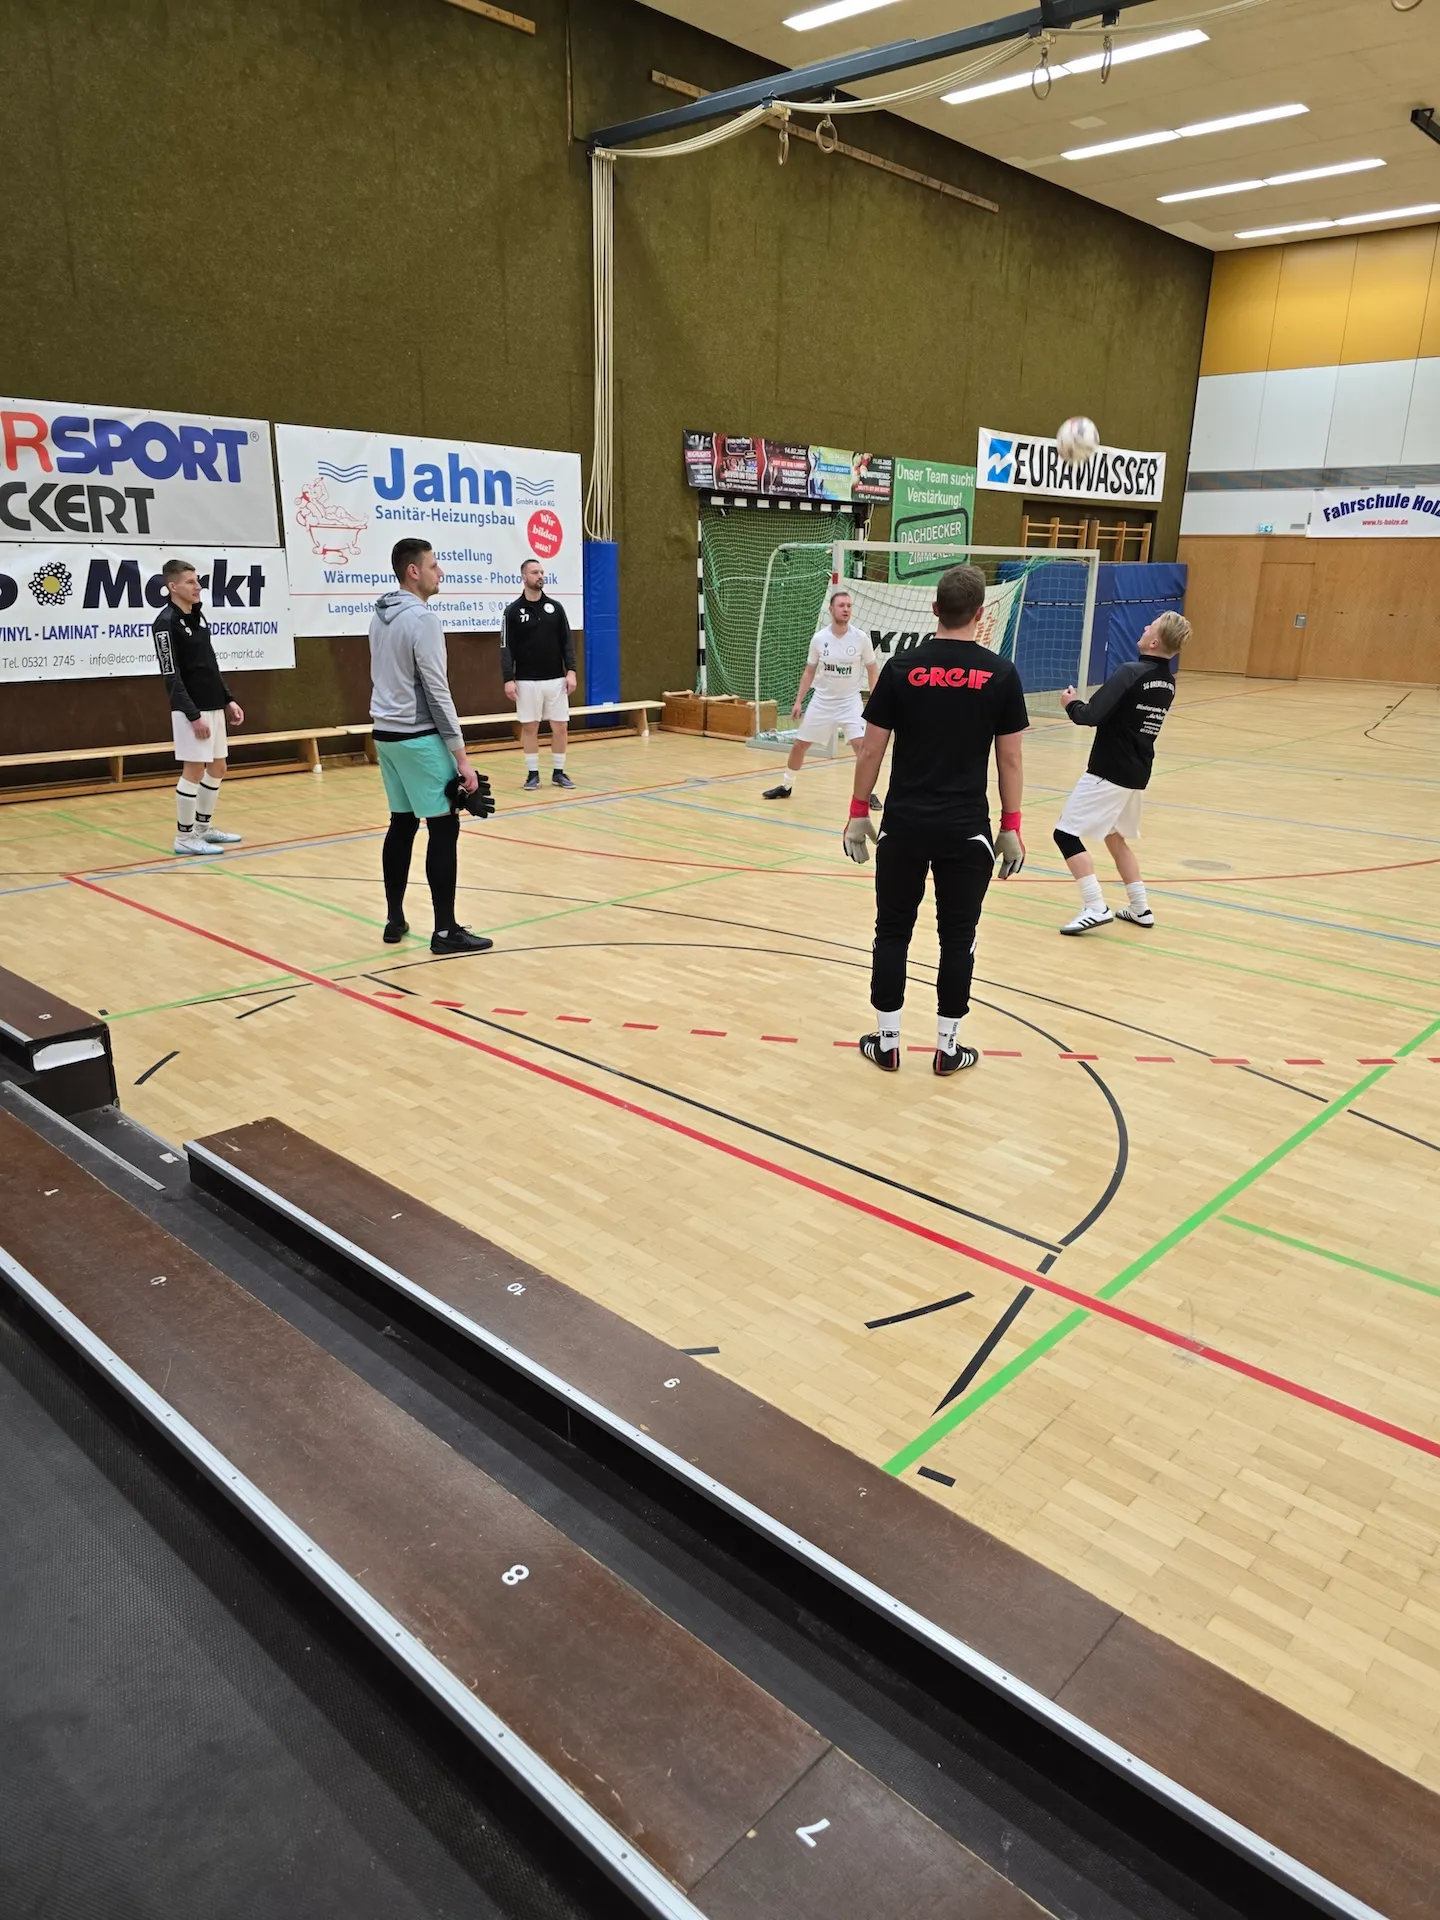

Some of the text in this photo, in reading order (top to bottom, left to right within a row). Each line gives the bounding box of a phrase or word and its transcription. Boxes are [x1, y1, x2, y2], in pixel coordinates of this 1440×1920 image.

[373, 447, 512, 507] Jahn
[896, 463, 974, 487] Unser Team sucht
[907, 487, 963, 509] Verstärkung!
[1323, 493, 1410, 522] Fahrschule
[375, 505, 515, 528] Sanitär-Heizungsbau
[540, 513, 556, 526] Wir
[532, 524, 558, 542] bilden
[901, 521, 962, 544] DACHDECKER
[433, 548, 493, 564] usstellung
[534, 542, 552, 554] aus!
[438, 573, 483, 584] omasse
[42, 624, 99, 640] LAMINAT
[108, 623, 153, 638] PARKET
[206, 621, 278, 636] RDEKORATION
[2, 657, 19, 668] Tel.
[22, 656, 48, 668] 05321
[53, 655, 76, 667] 2745
[501, 1564, 530, 1586] 8
